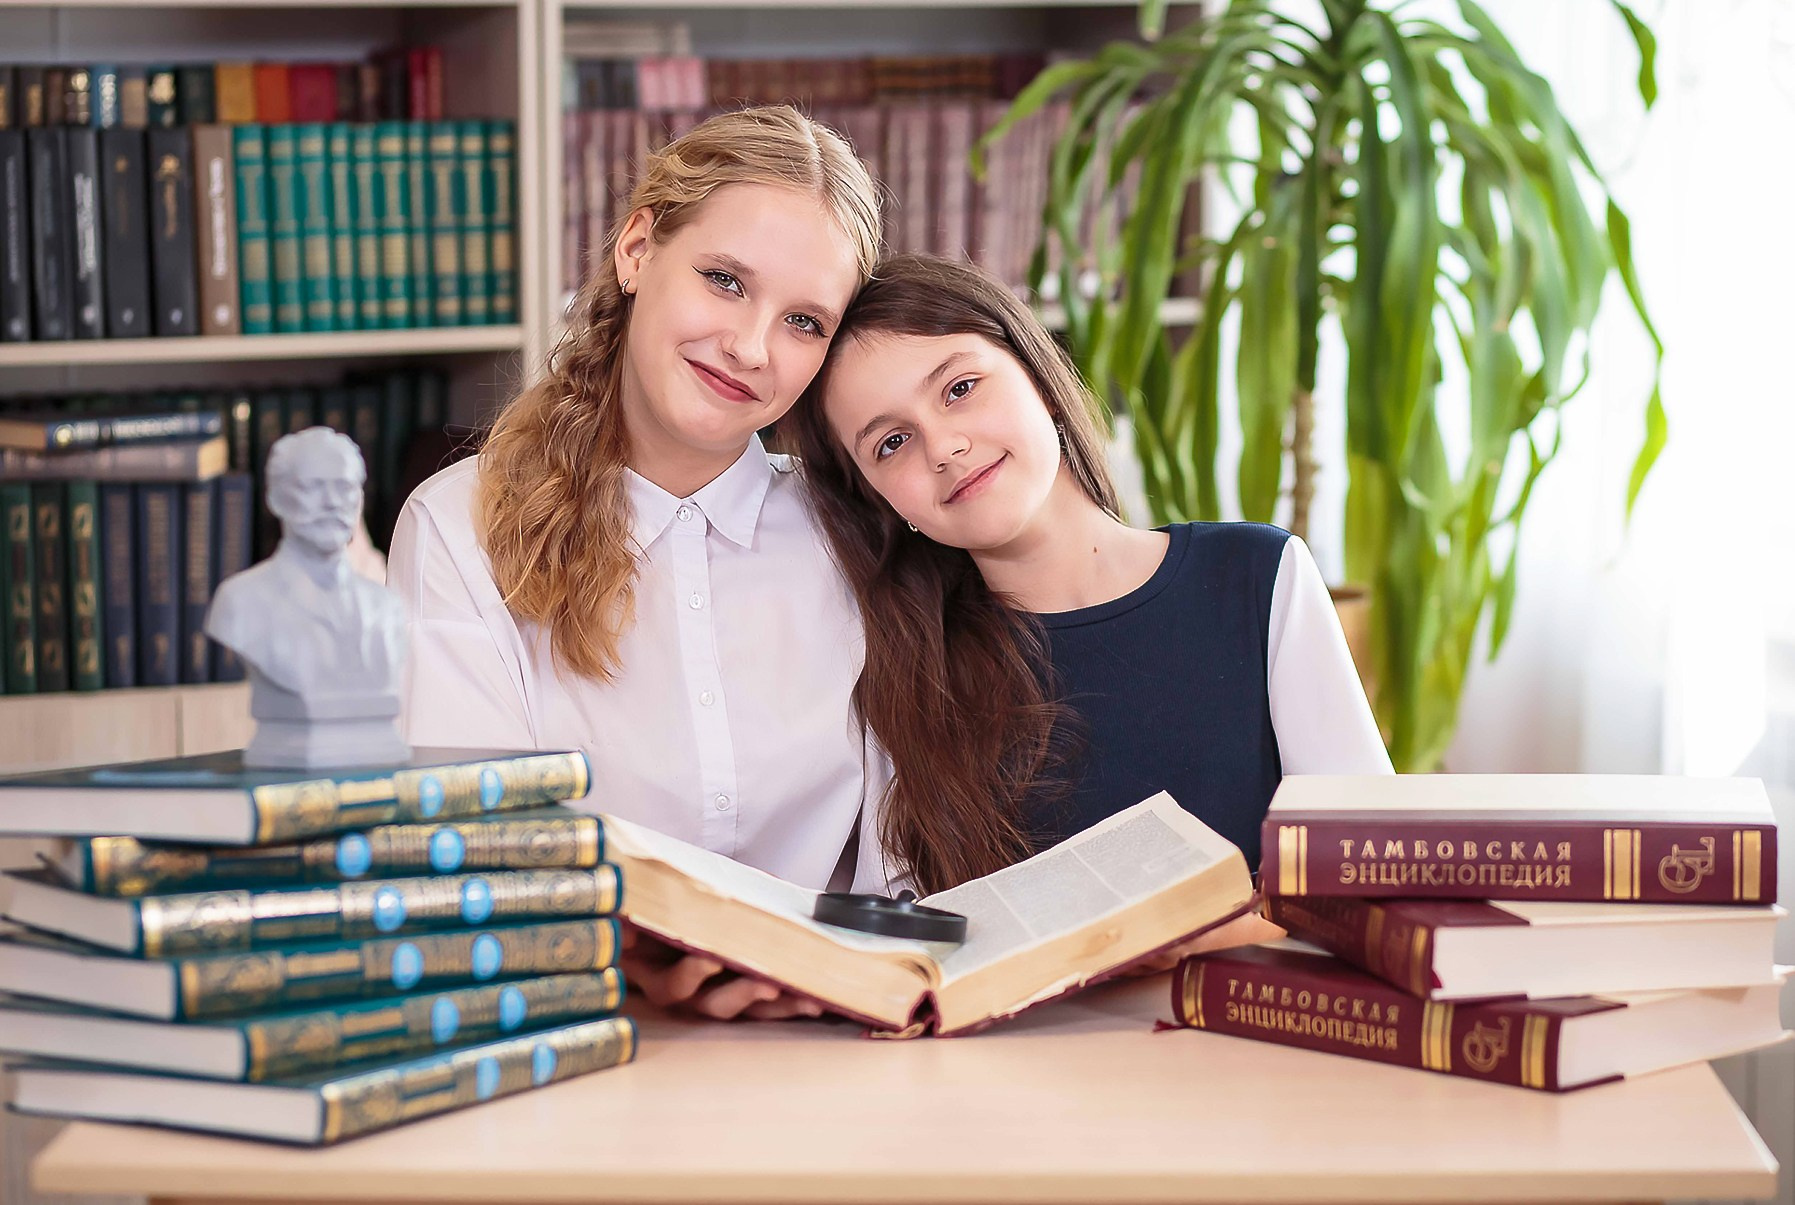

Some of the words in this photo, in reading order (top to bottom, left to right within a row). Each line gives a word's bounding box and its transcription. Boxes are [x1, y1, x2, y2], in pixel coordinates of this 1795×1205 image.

[1339, 839, 1572, 861] ТАМБОВСКАЯ
[1339, 862, 1572, 889] ЭНЦИКЛОПЕДИЯ
[1227, 978, 1400, 1024] ТАМБОВСКАЯ
[1225, 1001, 1398, 1050] ЭНЦИКЛОПЕДИЯ
